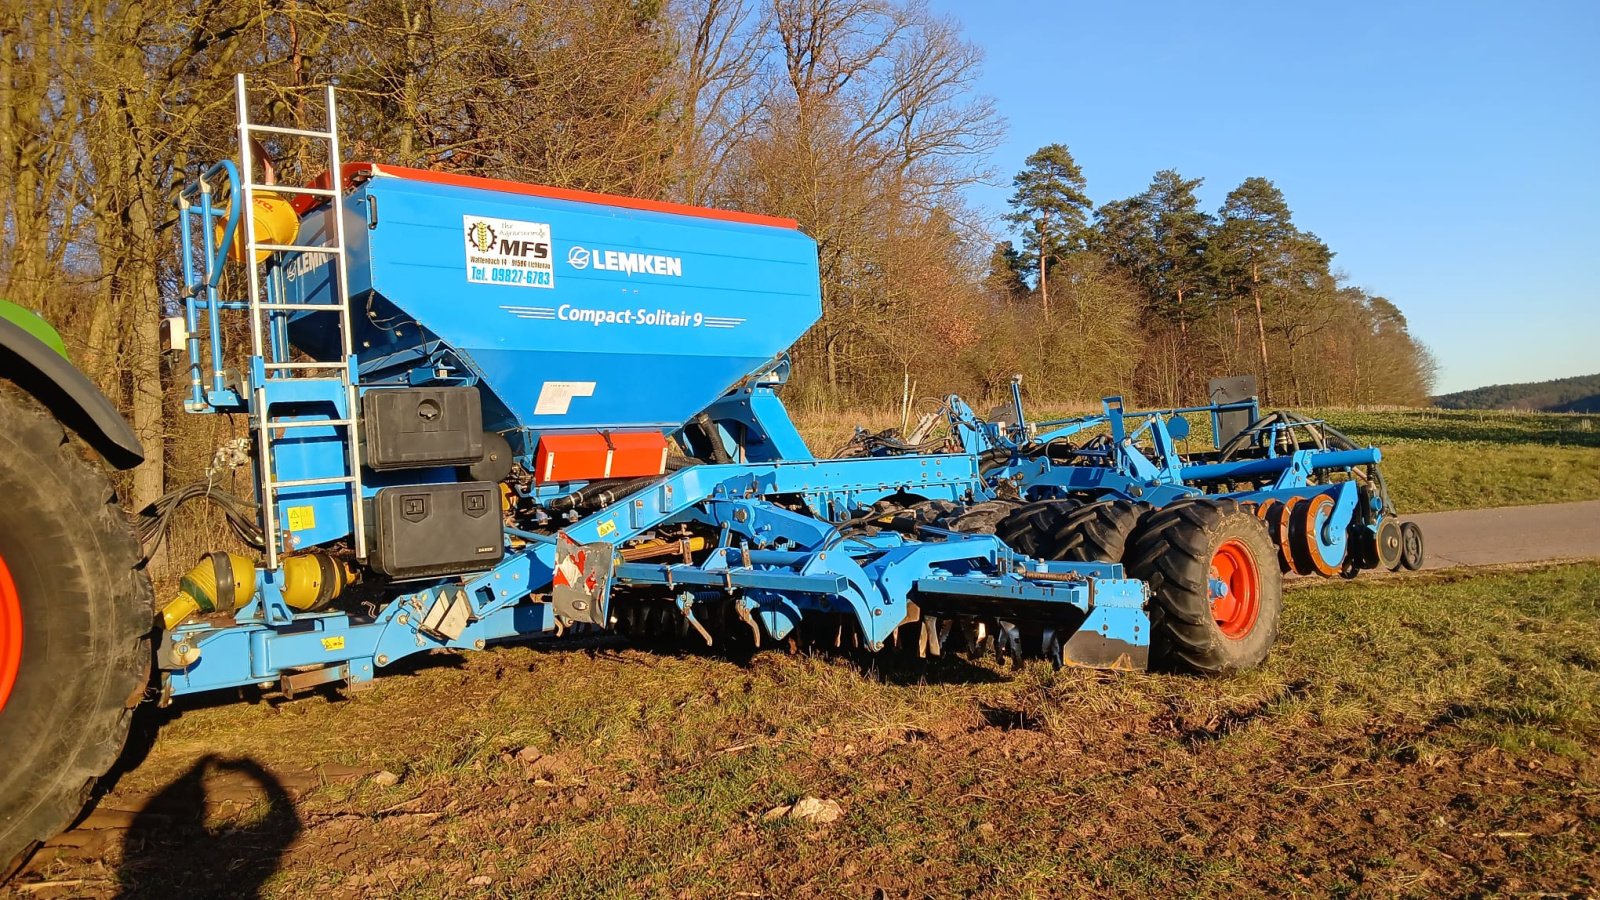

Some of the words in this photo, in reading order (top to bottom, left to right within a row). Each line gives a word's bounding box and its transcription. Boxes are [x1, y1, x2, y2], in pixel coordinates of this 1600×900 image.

[499, 239, 548, 258] MFS
[592, 249, 682, 277] LEMKEN
[471, 266, 488, 280] Tel.
[491, 267, 550, 285] 09827-6783
[557, 304, 692, 327] Compact-Solitair
[693, 312, 703, 327] 9
